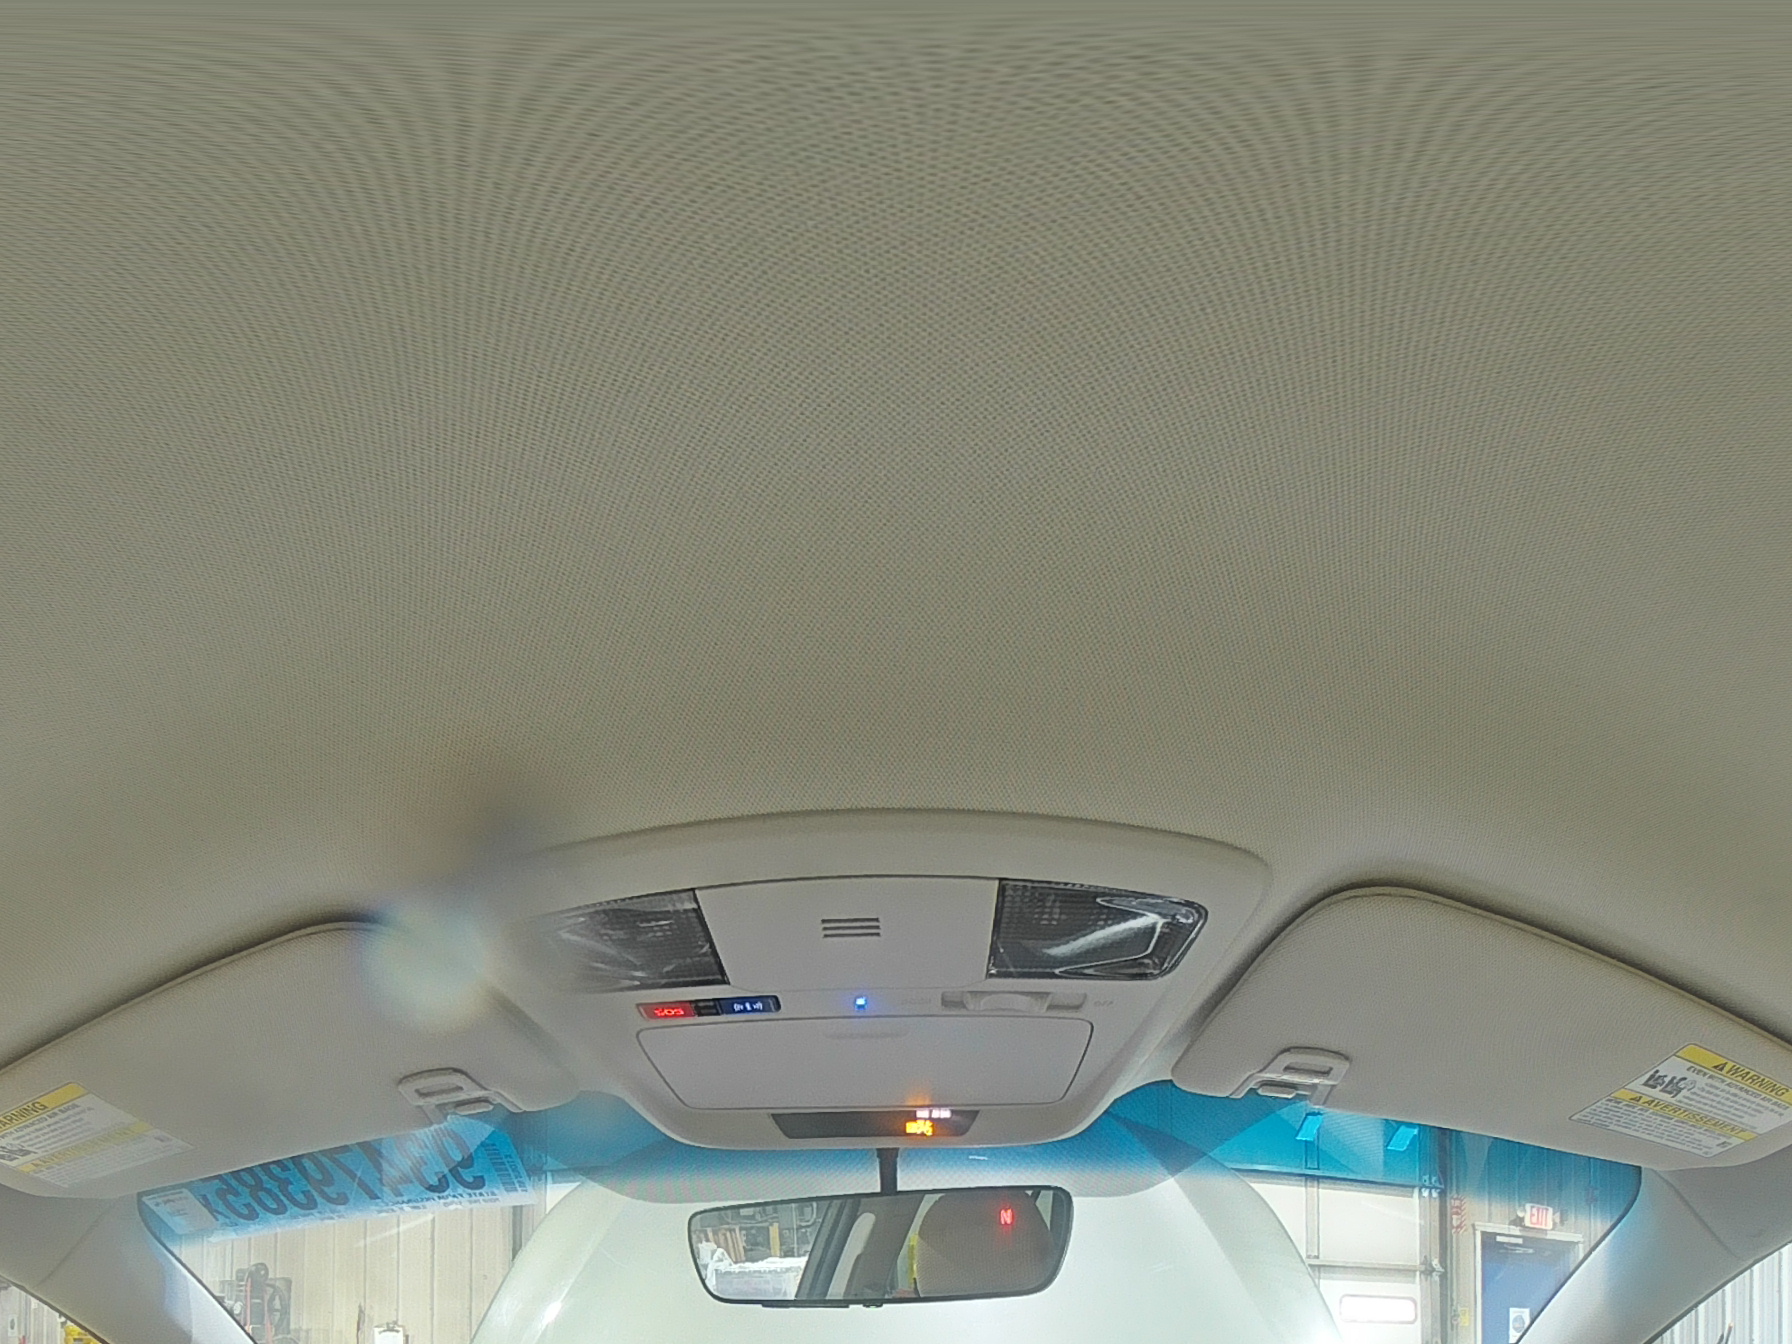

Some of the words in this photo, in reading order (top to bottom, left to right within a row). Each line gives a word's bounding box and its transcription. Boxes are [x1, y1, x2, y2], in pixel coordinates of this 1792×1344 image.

[1725, 1063, 1790, 1098] WARNING
[1643, 1098, 1747, 1136] AVERTISSEMENT
[1001, 1208, 1013, 1225] N
